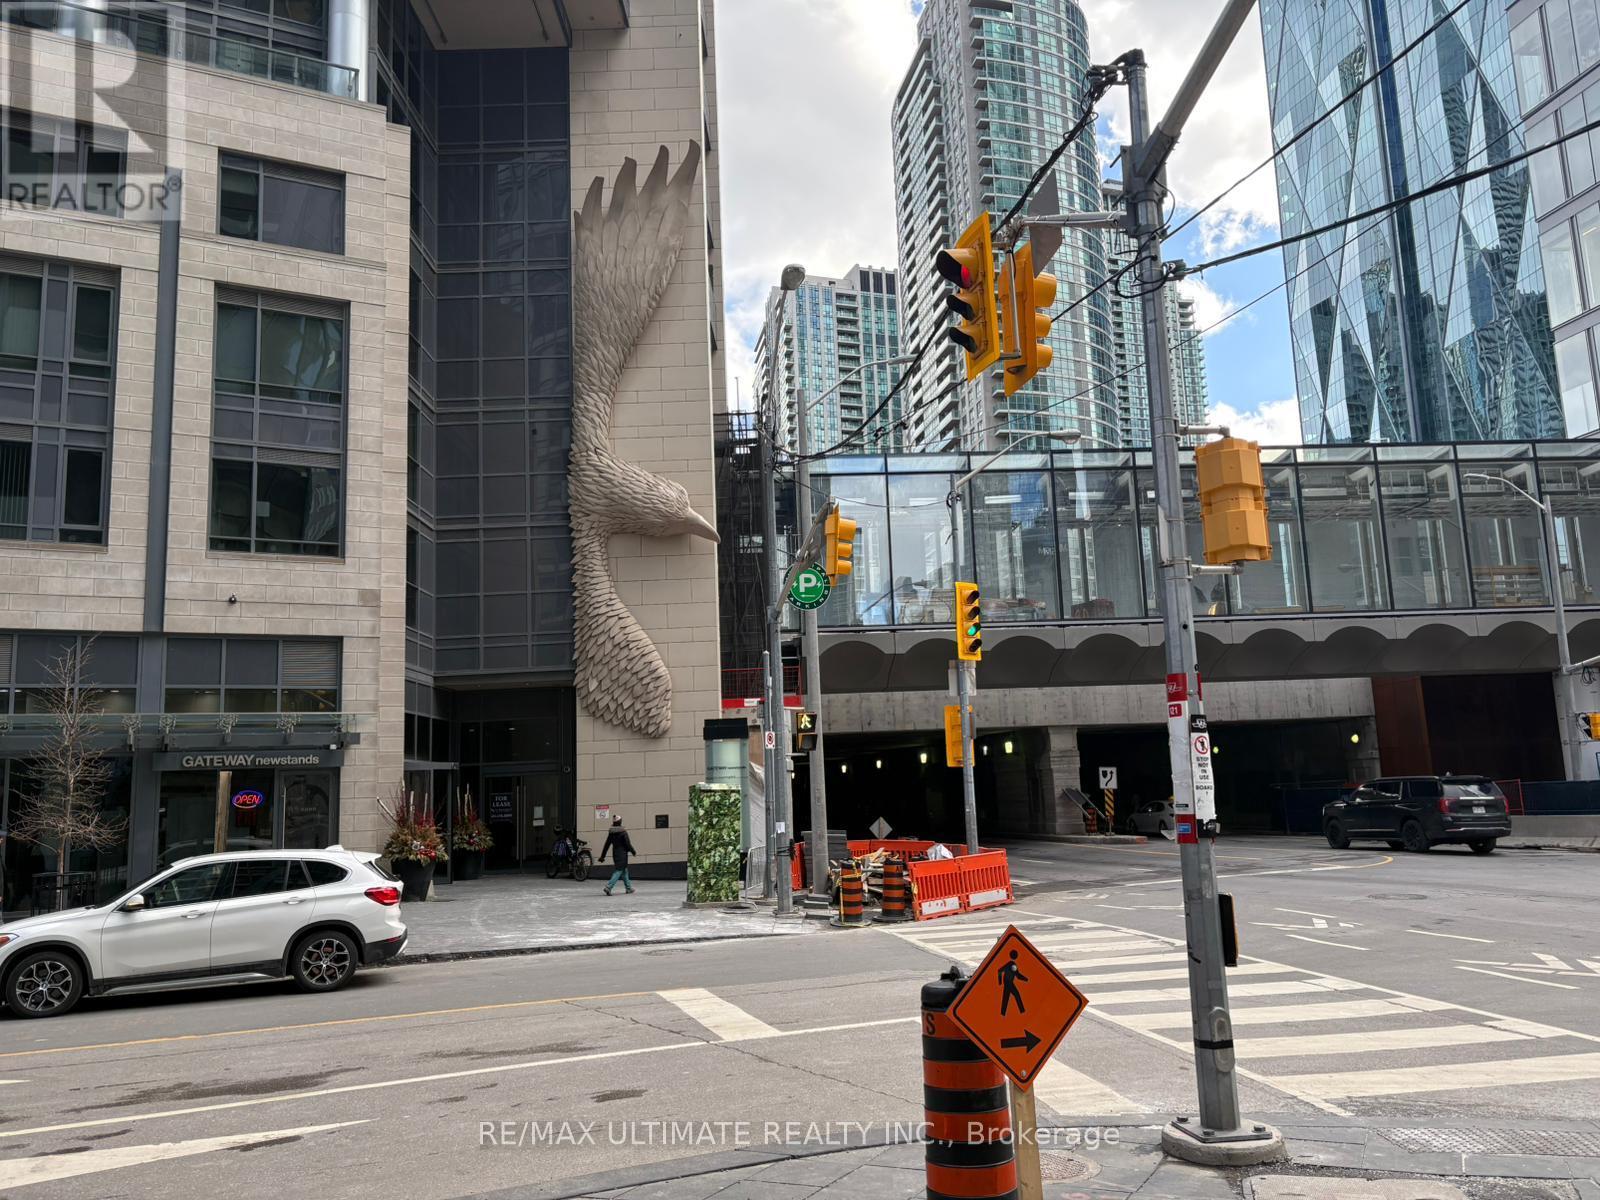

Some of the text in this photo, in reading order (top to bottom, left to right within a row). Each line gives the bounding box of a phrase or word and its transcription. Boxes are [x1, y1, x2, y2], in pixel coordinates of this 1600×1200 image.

[799, 573, 817, 592] P
[182, 754, 319, 767] GATEWAY newstands
[233, 794, 260, 805] OPEN
